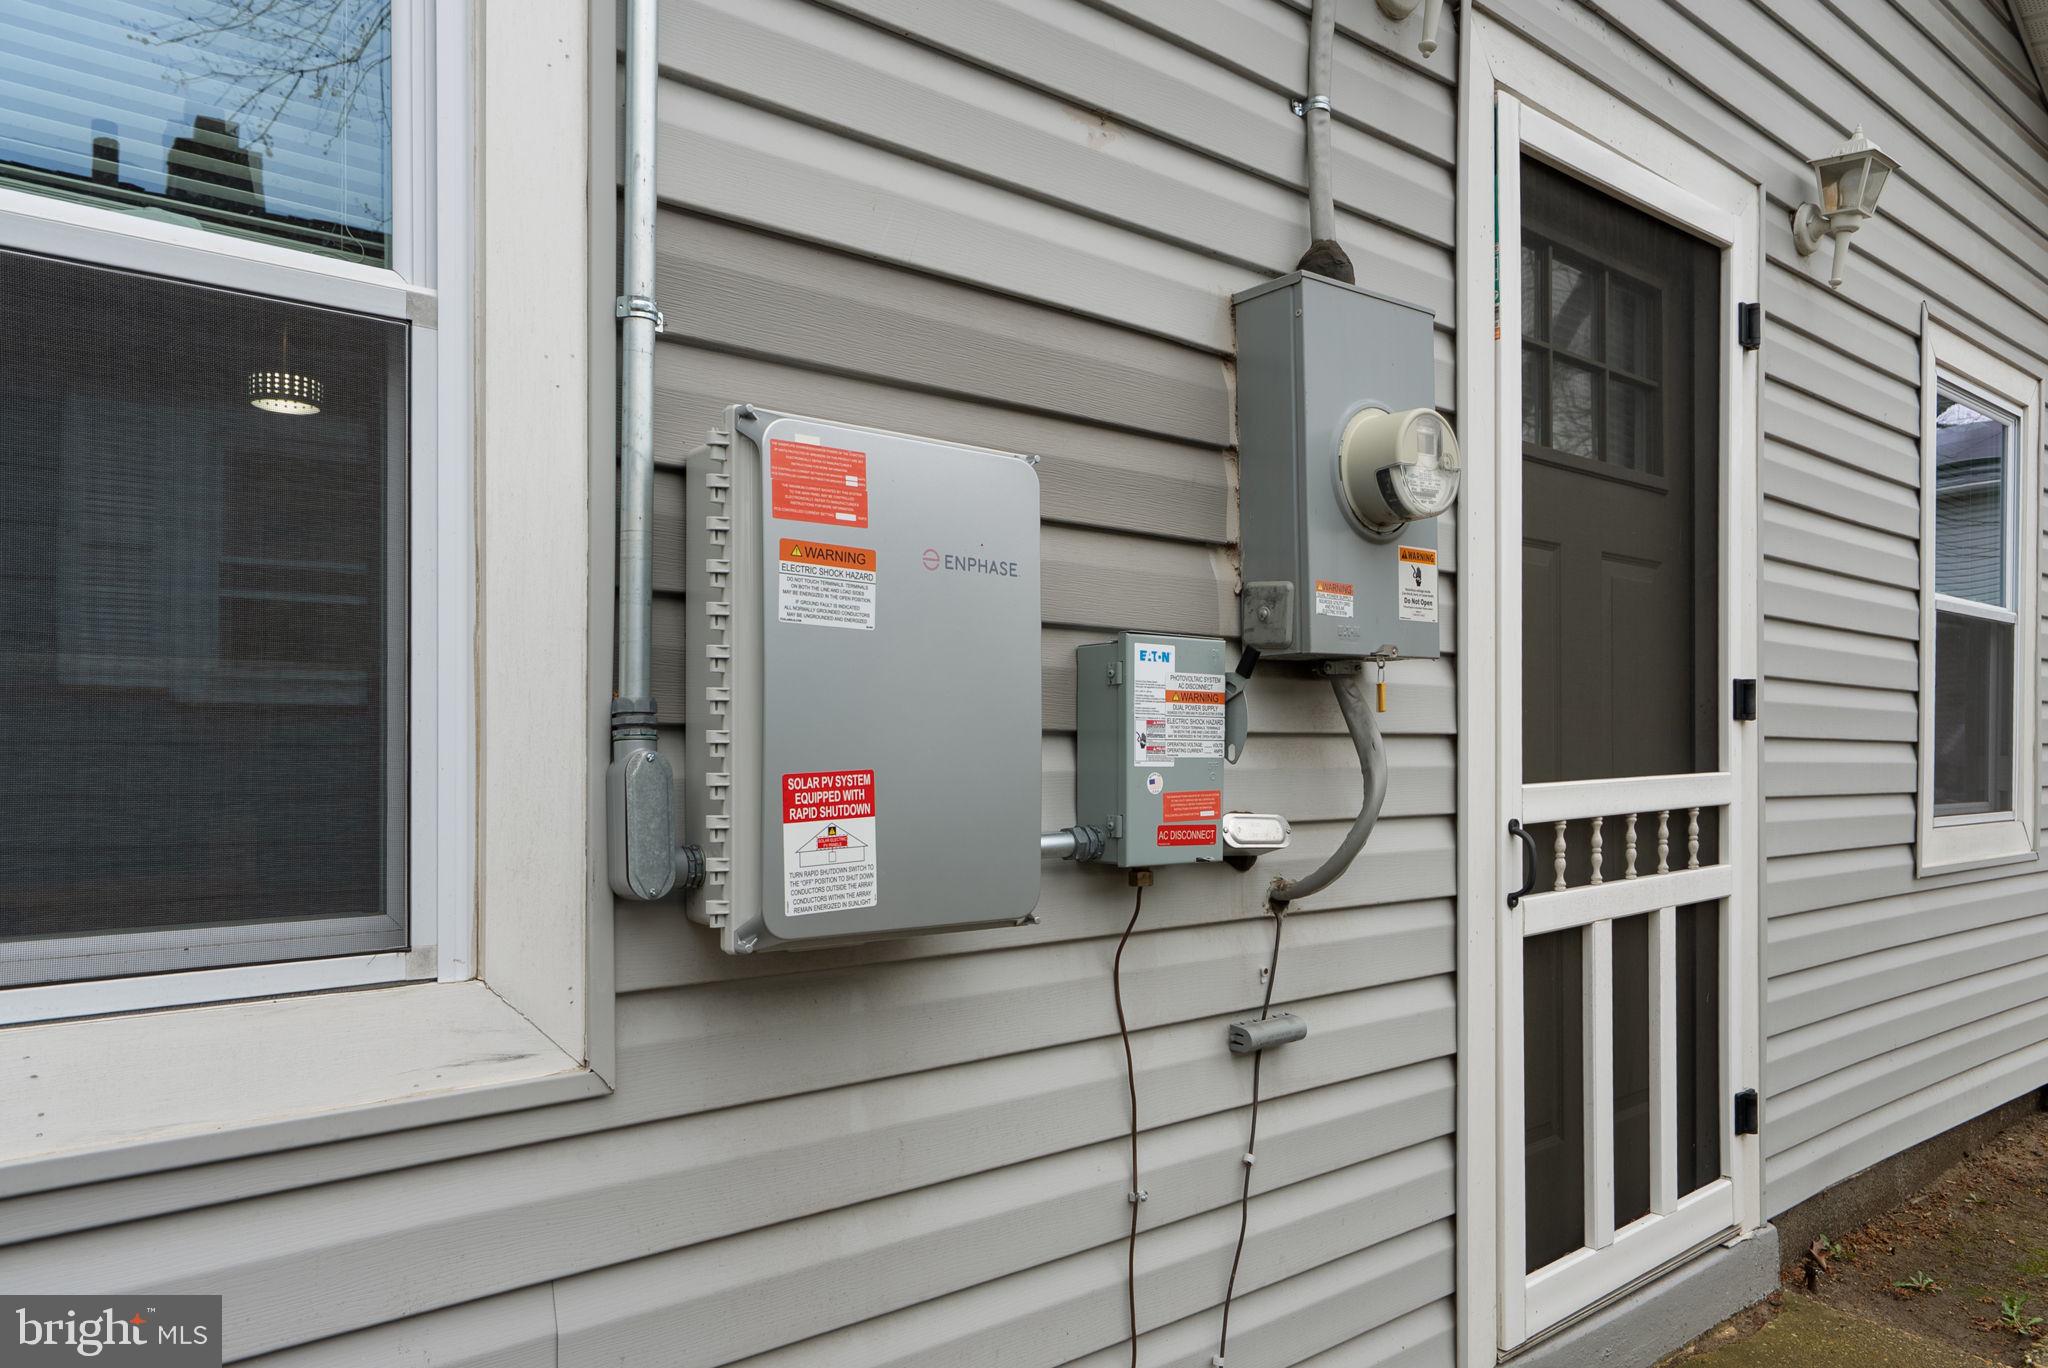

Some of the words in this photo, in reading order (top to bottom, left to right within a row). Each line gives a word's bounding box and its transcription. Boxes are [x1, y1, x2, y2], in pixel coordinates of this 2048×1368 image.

[804, 546, 866, 565] WARNING
[1407, 551, 1435, 563] WARNING
[781, 563, 817, 574] ELECTRIC
[819, 567, 844, 578] SHOCK
[845, 571, 874, 582] HAZARD
[945, 554, 1018, 578] ENPHASE
[1411, 597, 1420, 605] Not
[1420, 598, 1433, 607] Open
[841, 610, 871, 618] CONDUCTORS
[1170, 675, 1203, 683] PHOTOVOLTAIC
[1203, 676, 1222, 684] SYSTEM
[1181, 692, 1220, 703] WARNING
[1167, 717, 1190, 725] ELECTRIC
[787, 777, 820, 791] SOLAR
[821, 776, 834, 788] PV
[834, 773, 871, 787] SYSTEM
[795, 790, 841, 805] EQUIPPED
[842, 788, 866, 802] WITH
[789, 806, 818, 820] RAPID
[819, 803, 872, 818] SHUTDOWN
[1158, 830, 1169, 840] AC
[1170, 830, 1215, 840] DISCONNECT
[789, 871, 804, 879] TURN
[803, 869, 819, 877] RAPID
[819, 866, 848, 876] SHUTDOWN
[848, 865, 867, 873] SWITCH
[814, 876, 838, 884] POSITION
[845, 873, 859, 881] SHUT
[859, 872, 874, 880] DOWN
[791, 887, 826, 896] CONDUCTORS
[826, 884, 848, 892] OUTSIDE
[793, 895, 828, 905] CONDUCTORS
[828, 893, 846, 901] WITHIN
[855, 890, 872, 898] ARRAY
[793, 906, 813, 914] REMAIN
[813, 902, 841, 911] ENERGIZED
[847, 898, 871, 907] SUNLIGHT
